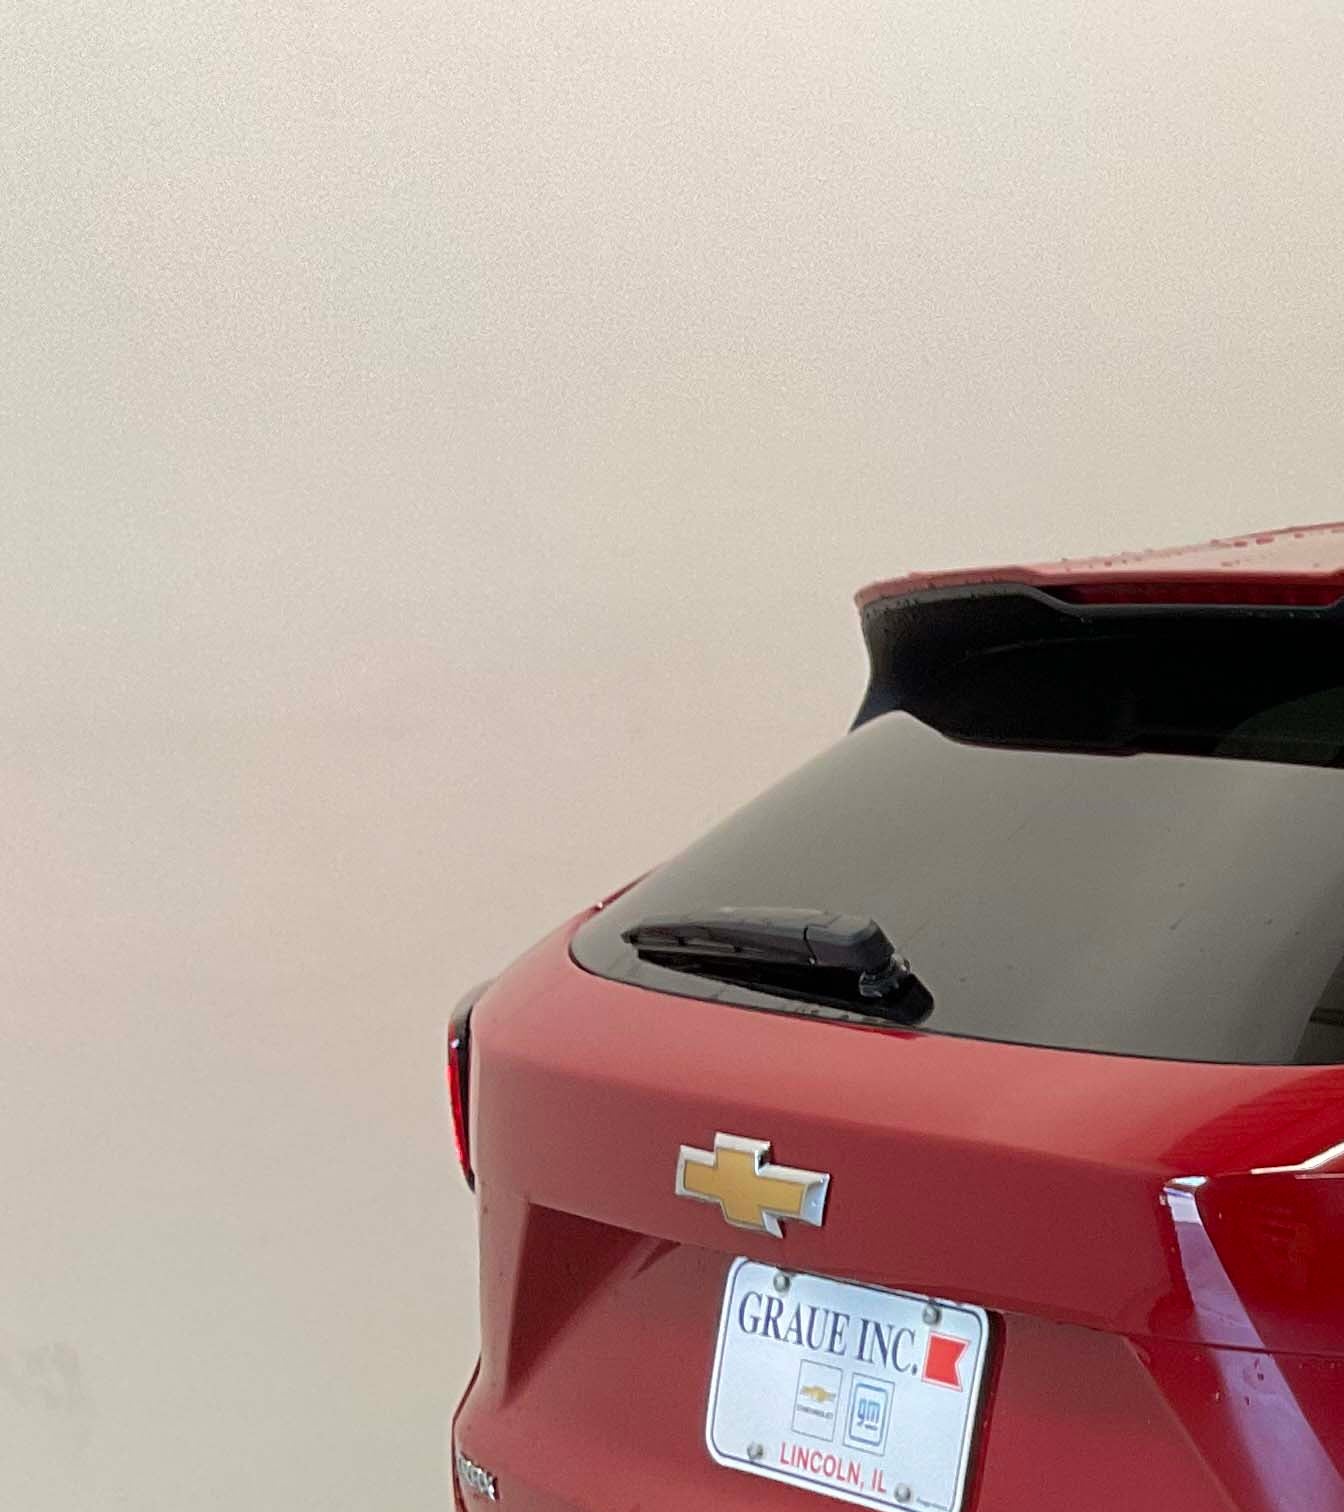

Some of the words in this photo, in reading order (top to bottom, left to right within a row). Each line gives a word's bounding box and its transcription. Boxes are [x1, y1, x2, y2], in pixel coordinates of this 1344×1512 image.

[738, 1291, 850, 1357] GRAUE
[856, 1317, 919, 1376] INC.
[779, 1442, 867, 1490] LINCOLN,
[871, 1467, 888, 1494] IL
